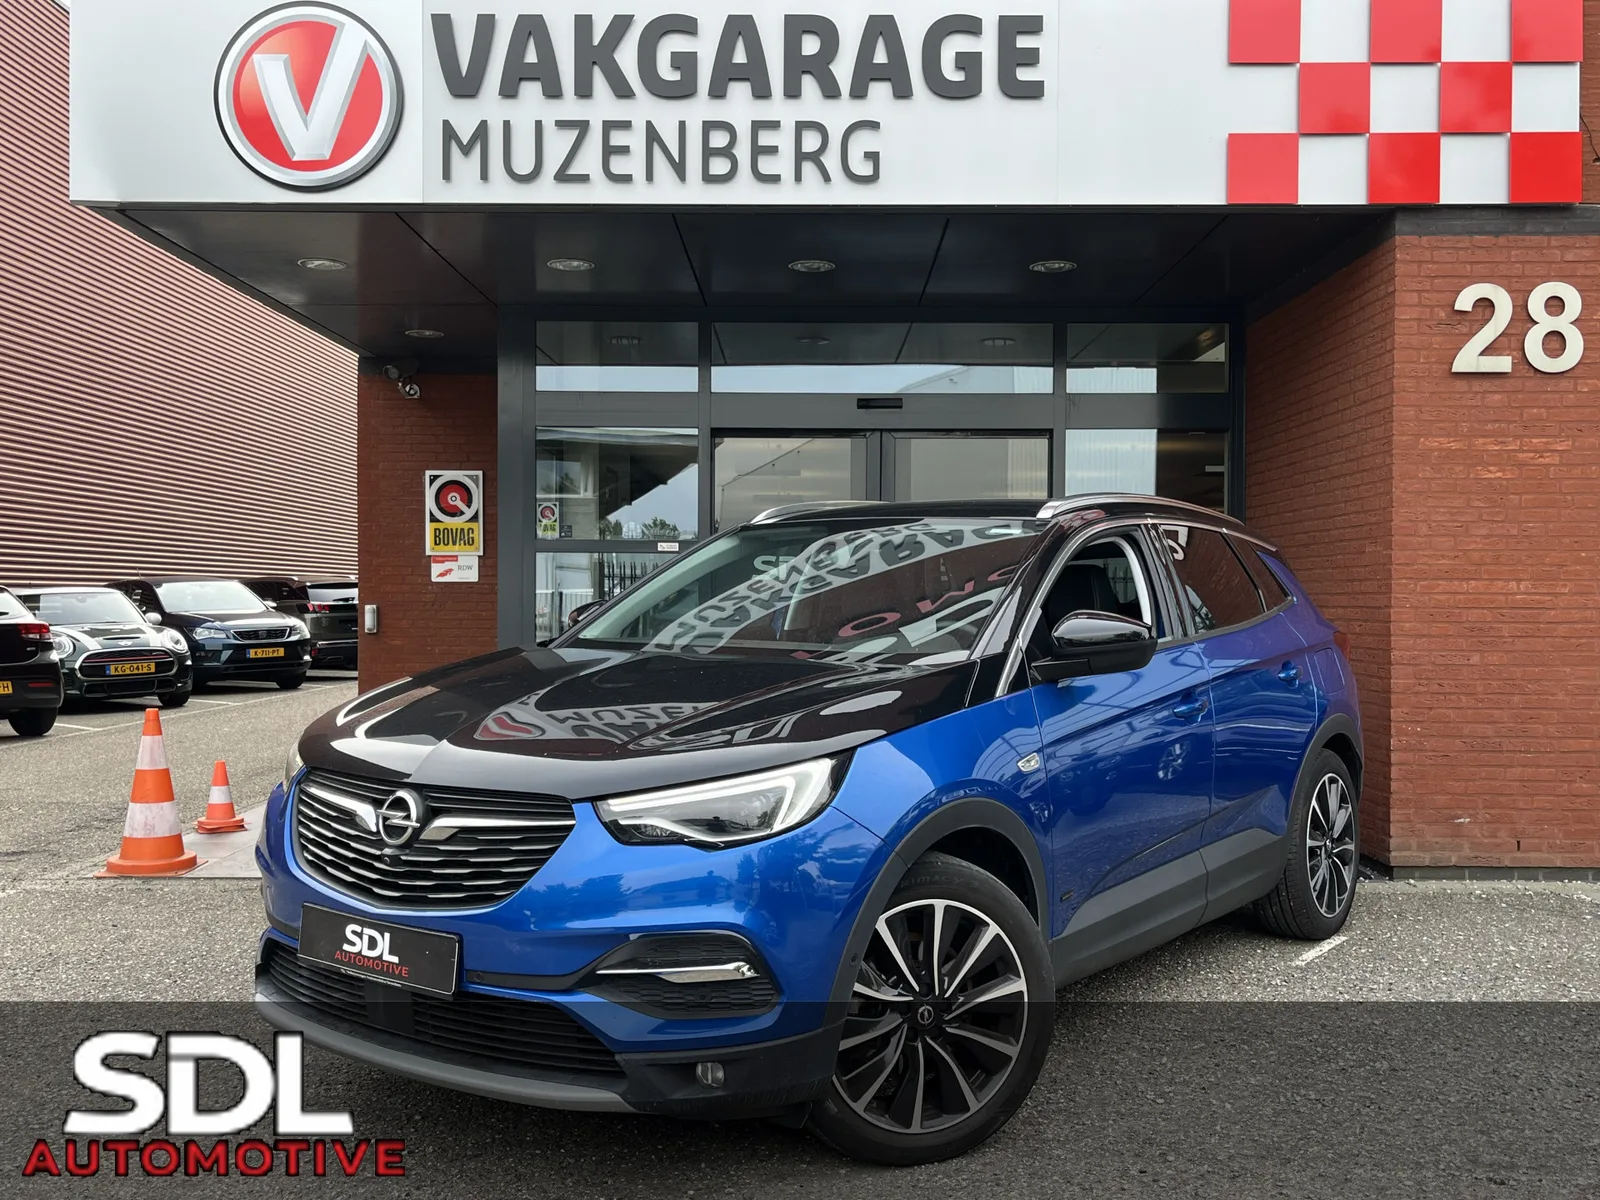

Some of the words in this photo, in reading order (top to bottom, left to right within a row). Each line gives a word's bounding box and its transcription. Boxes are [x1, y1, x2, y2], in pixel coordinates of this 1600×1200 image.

[430, 14, 1045, 99] VAKGARAGE
[442, 120, 881, 183] MUZENBERG
[1451, 281, 1584, 374] 28
[433, 527, 475, 546] BOVAG
[114, 664, 152, 673] KG-041-S
[334, 950, 409, 978] AUTOMOTIVE
[342, 923, 400, 964] SDL
